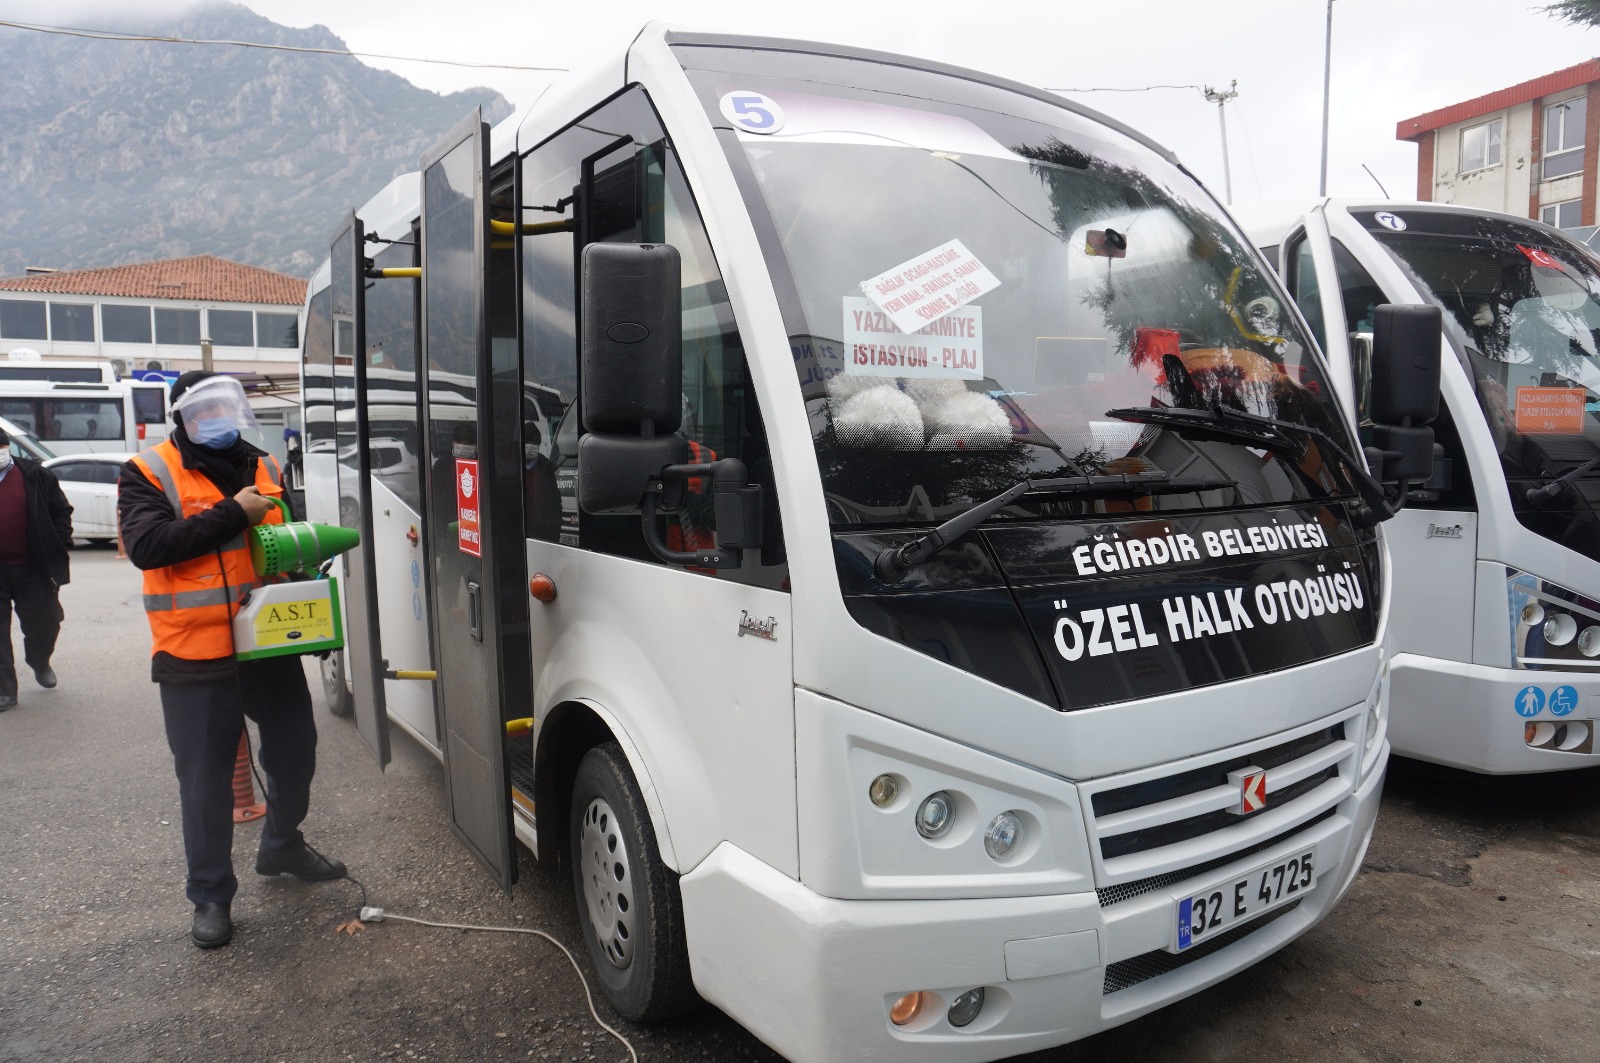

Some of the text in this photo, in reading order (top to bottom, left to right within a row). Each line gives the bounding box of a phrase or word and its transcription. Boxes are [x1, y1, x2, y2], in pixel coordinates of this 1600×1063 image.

[732, 96, 775, 128] 5
[1380, 215, 1399, 229] 7
[942, 347, 977, 370] PLAJ
[1072, 517, 1329, 576] EĞİRDİR BELEDİYESİ
[267, 602, 317, 624] A.S.T
[1054, 562, 1365, 662] ÖZEL HALK OTOBÜSÜ
[1192, 852, 1313, 936] 32 E 4725
[1180, 926, 1190, 938] TR
